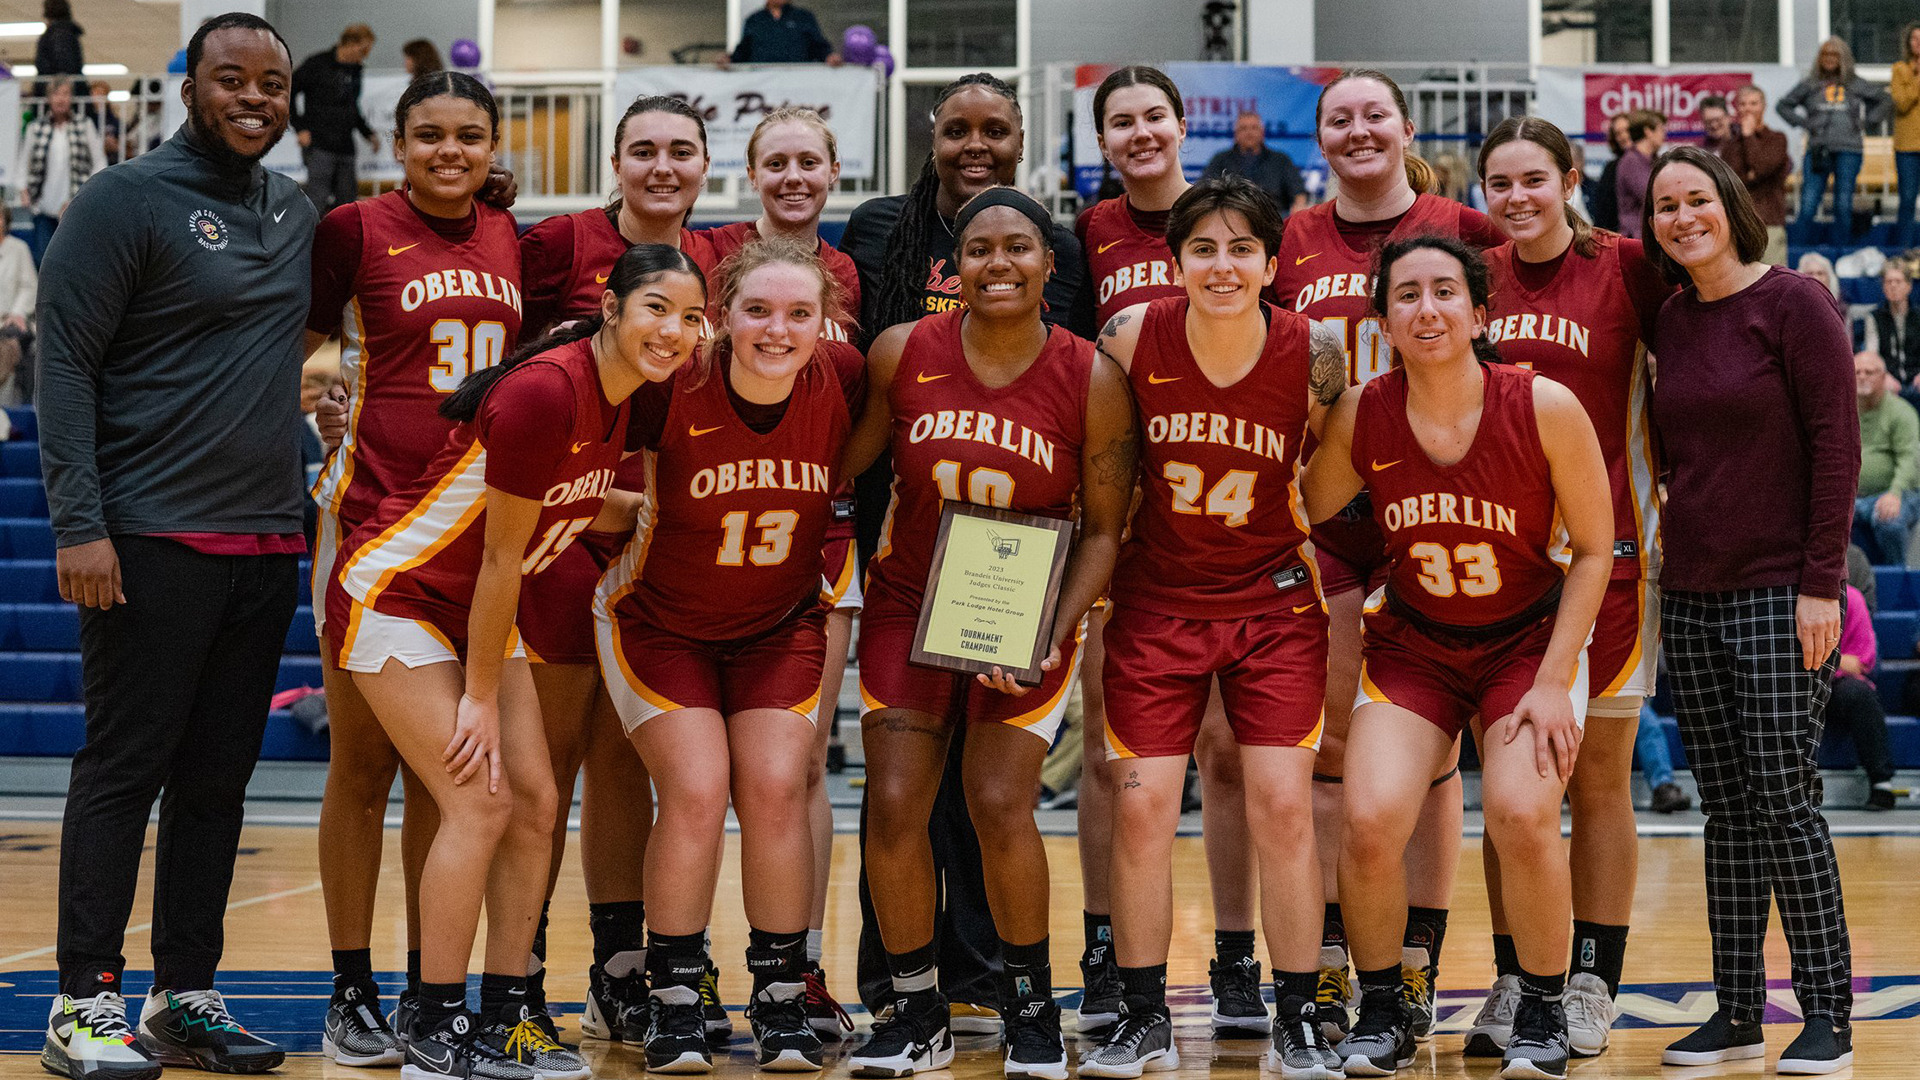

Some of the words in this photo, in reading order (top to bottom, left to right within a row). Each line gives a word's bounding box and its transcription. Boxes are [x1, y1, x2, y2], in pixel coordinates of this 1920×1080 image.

[203, 209, 227, 233] COLLEGE
[197, 237, 228, 251] BASKETBALL
[401, 269, 522, 321] OBERLIN
[428, 318, 507, 393] 30
[1483, 313, 1590, 358] BERLIN
[909, 409, 1055, 475] OBERLIN
[1148, 412, 1286, 464] OBERLIN
[542, 468, 616, 507] OBERLI
[689, 458, 830, 500] OBERLIN
[931, 458, 1016, 513] 10
[1163, 460, 1259, 528] 24
[1384, 492, 1517, 536] OBERLIN
[521, 516, 595, 576] 15
[716, 509, 800, 567] 13
[1623, 544, 1634, 553] XL
[964, 569, 991, 580] Brandeis
[992, 574, 1025, 587] University
[969, 579, 991, 589] Judges
[992, 583, 1017, 593] Classic
[988, 565, 1005, 573] 2023
[1296, 570, 1305, 579] M
[1408, 541, 1503, 598] 33
[950, 599, 966, 607] Park
[966, 602, 986, 611] Lodge
[986, 605, 1005, 614] Hotel
[1005, 608, 1025, 617] Group
[969, 594, 995, 603] Presented
[960, 628, 1003, 644] TOURNAMENT
[960, 640, 999, 655] CHAMPIONS
